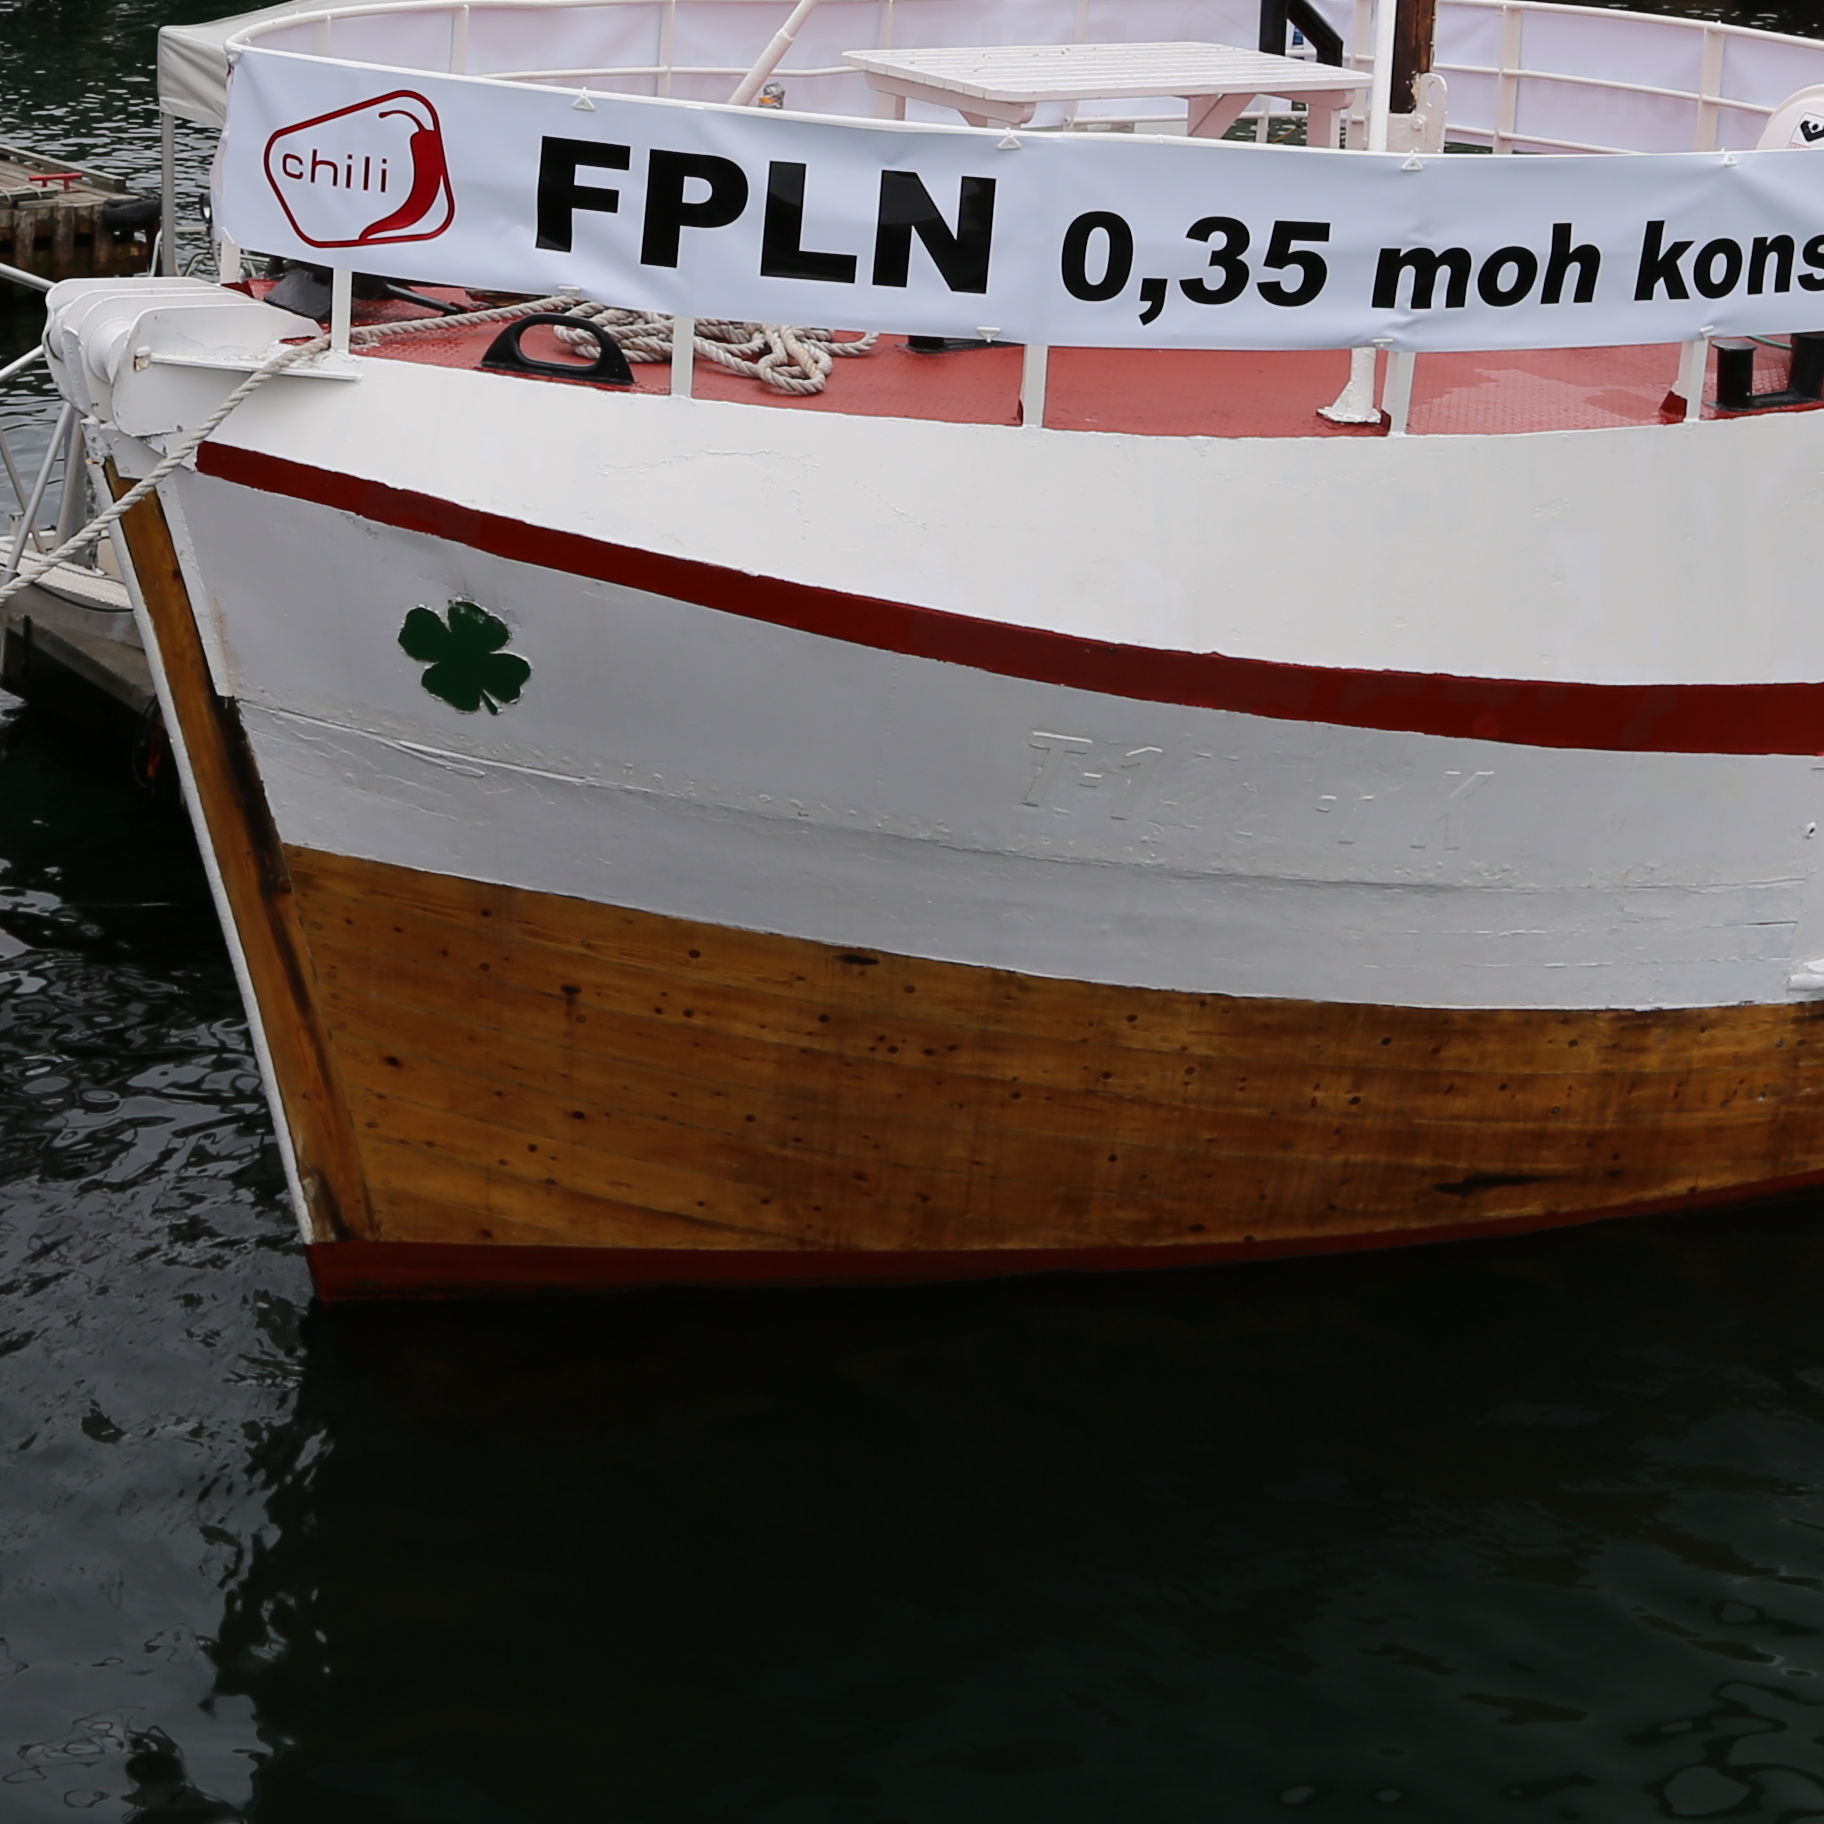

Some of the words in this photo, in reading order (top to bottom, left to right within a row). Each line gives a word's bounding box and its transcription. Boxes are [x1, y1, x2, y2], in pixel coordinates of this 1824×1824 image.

[281, 148, 389, 196] chili
[534, 133, 998, 296] FPLN
[1059, 210, 1332, 326] 0,35
[1371, 220, 1600, 311] moh
